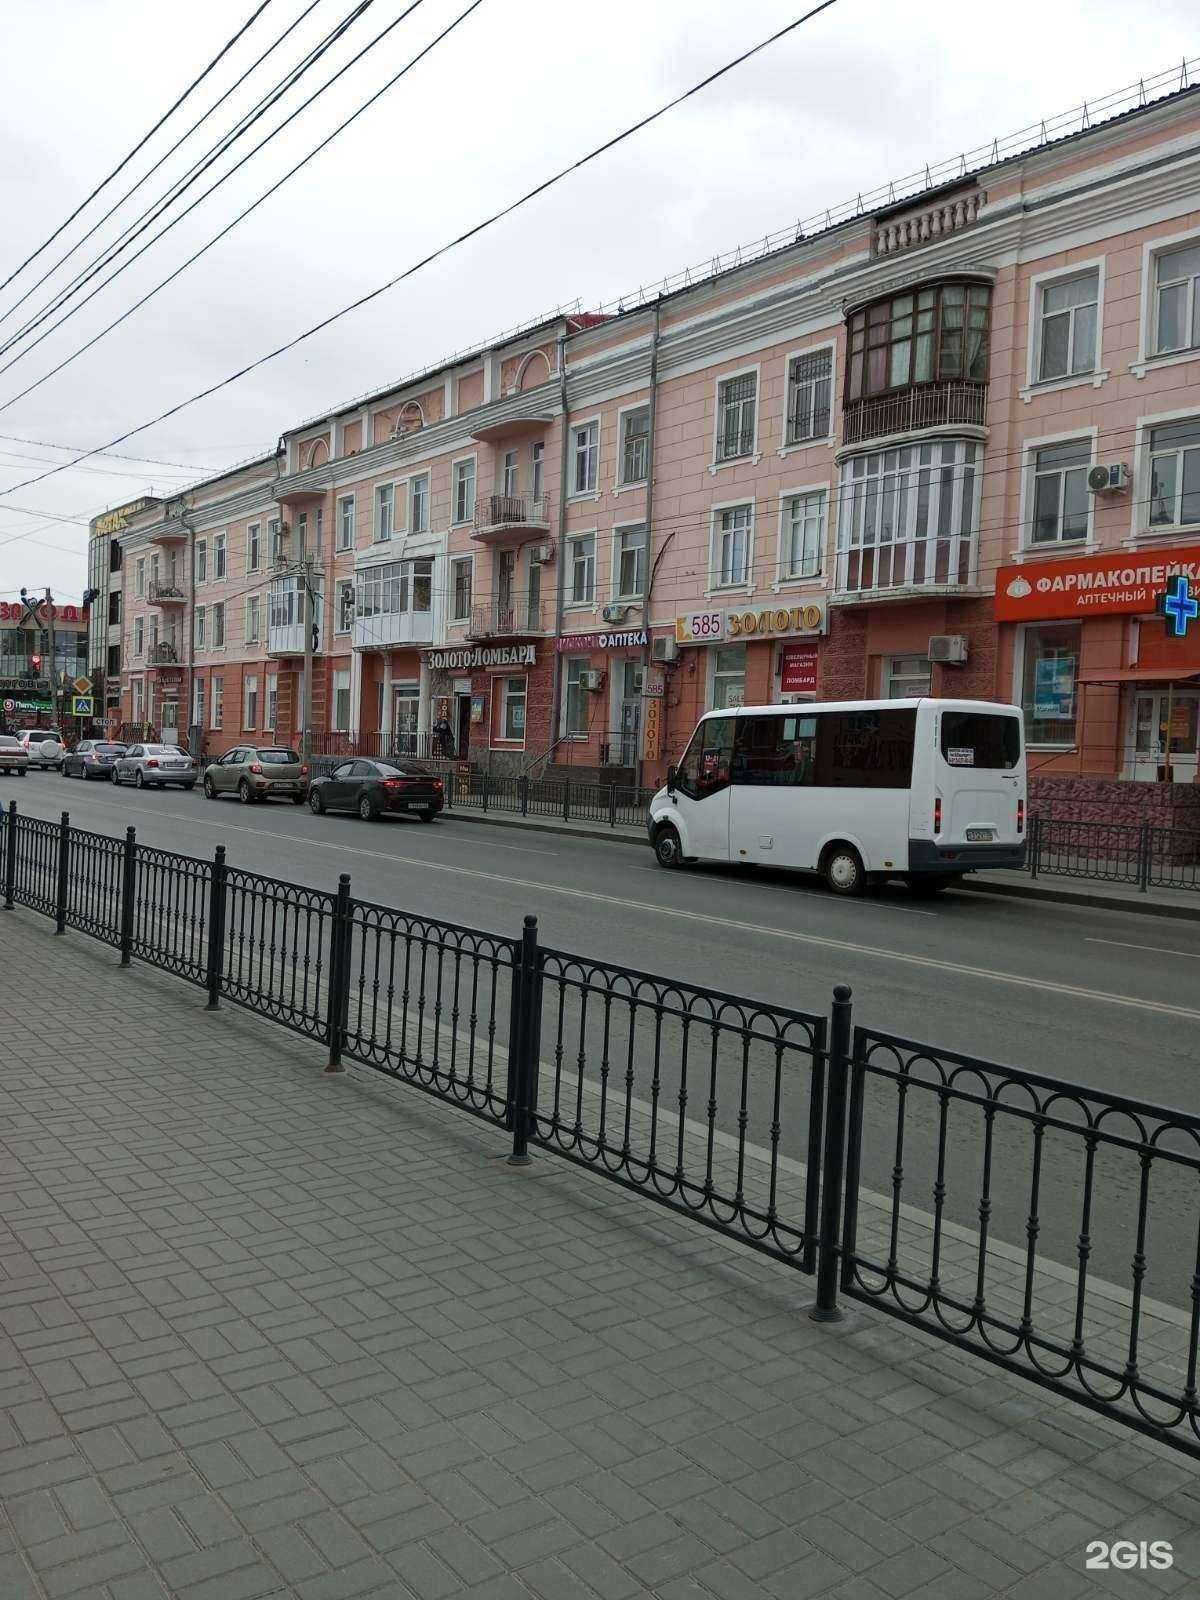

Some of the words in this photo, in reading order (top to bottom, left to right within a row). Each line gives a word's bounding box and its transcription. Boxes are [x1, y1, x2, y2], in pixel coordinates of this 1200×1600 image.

[1077, 588, 1146, 605] АПТЕЧНЫЙ
[692, 614, 720, 635] 585
[727, 605, 820, 635] ЗОЛОТО
[608, 632, 648, 648] АПТЕКА
[786, 676, 815, 685] ЛОМБАРД
